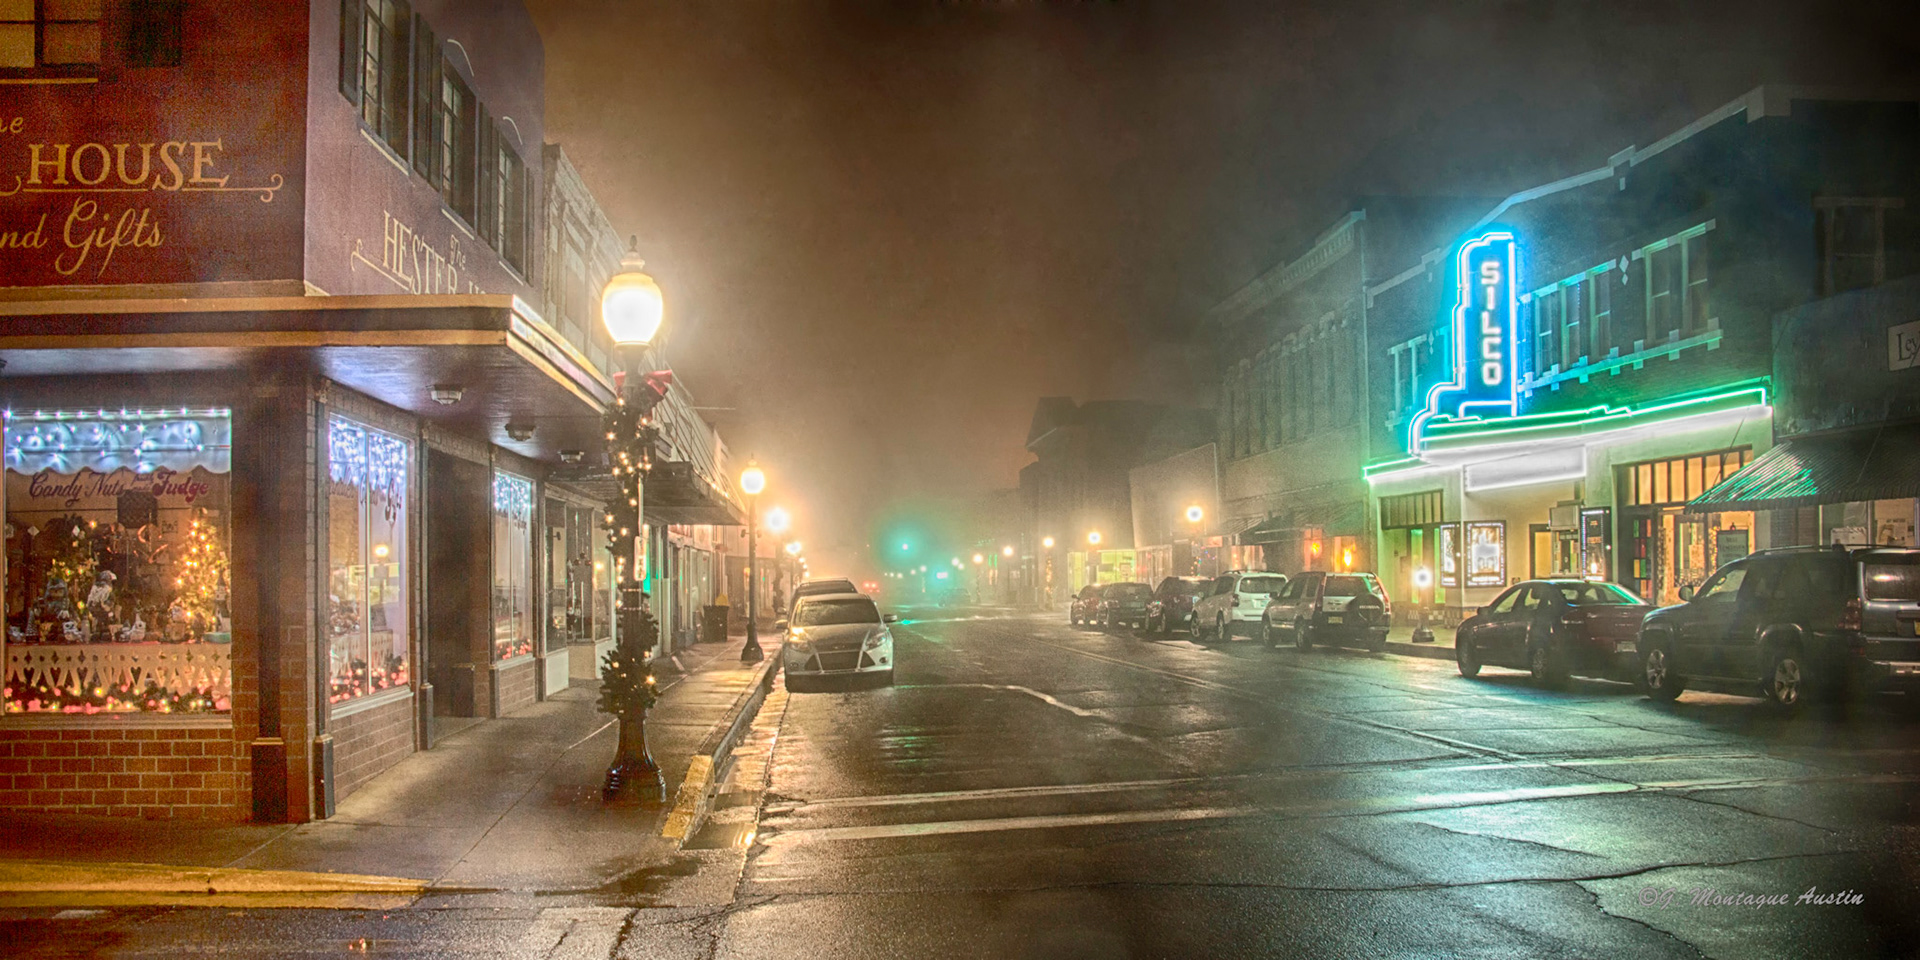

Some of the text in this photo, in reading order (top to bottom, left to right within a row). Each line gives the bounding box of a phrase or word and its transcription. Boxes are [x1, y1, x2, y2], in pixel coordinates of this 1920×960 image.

[26, 137, 230, 191] HOUSE
[54, 196, 164, 277] Gifts
[383, 209, 457, 295] HESTER
[450, 234, 466, 271] The
[1480, 260, 1503, 386] SILCO
[29, 471, 81, 507] Candy
[85, 470, 125, 498] Nuts
[152, 470, 209, 502] Fudge
